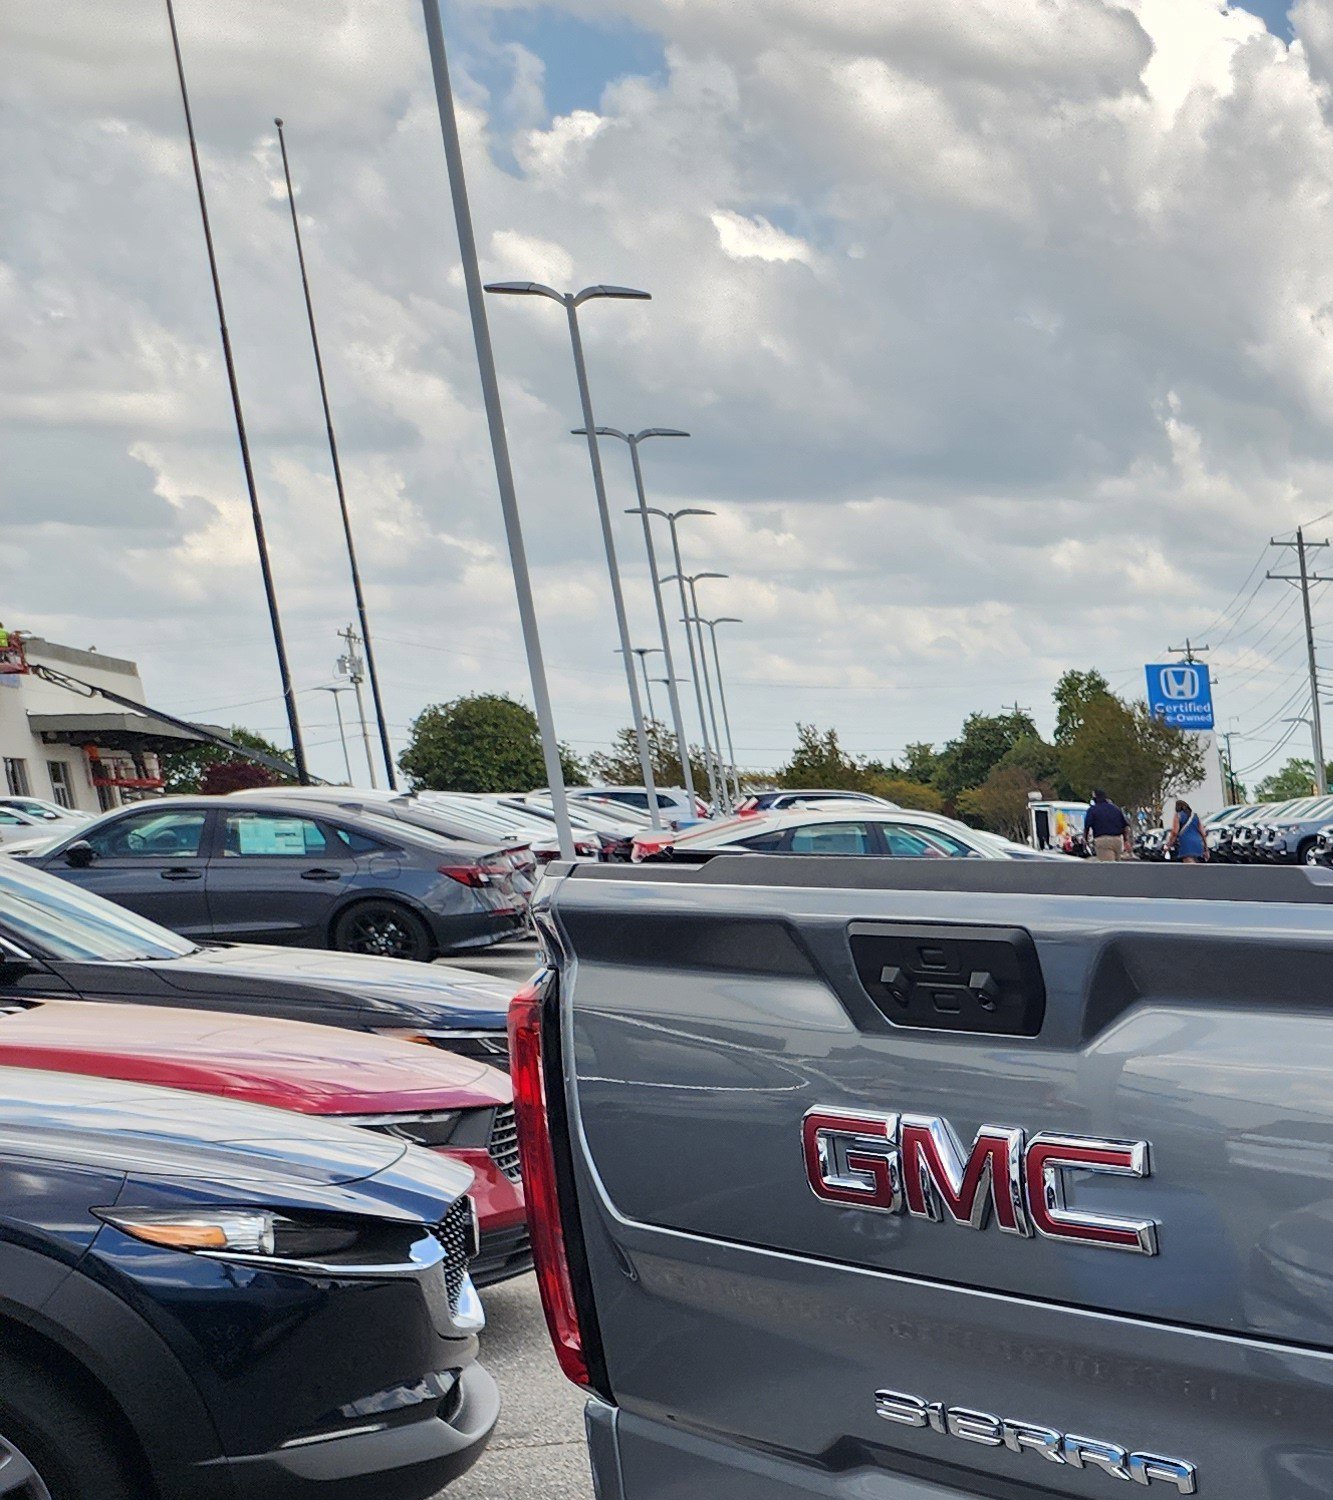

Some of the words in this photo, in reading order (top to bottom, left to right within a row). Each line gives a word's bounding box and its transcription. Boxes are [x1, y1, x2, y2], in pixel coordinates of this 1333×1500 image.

[1154, 702, 1212, 713] Certified
[802, 1103, 1161, 1256] GMC
[874, 1389, 1197, 1494] SIERRA
